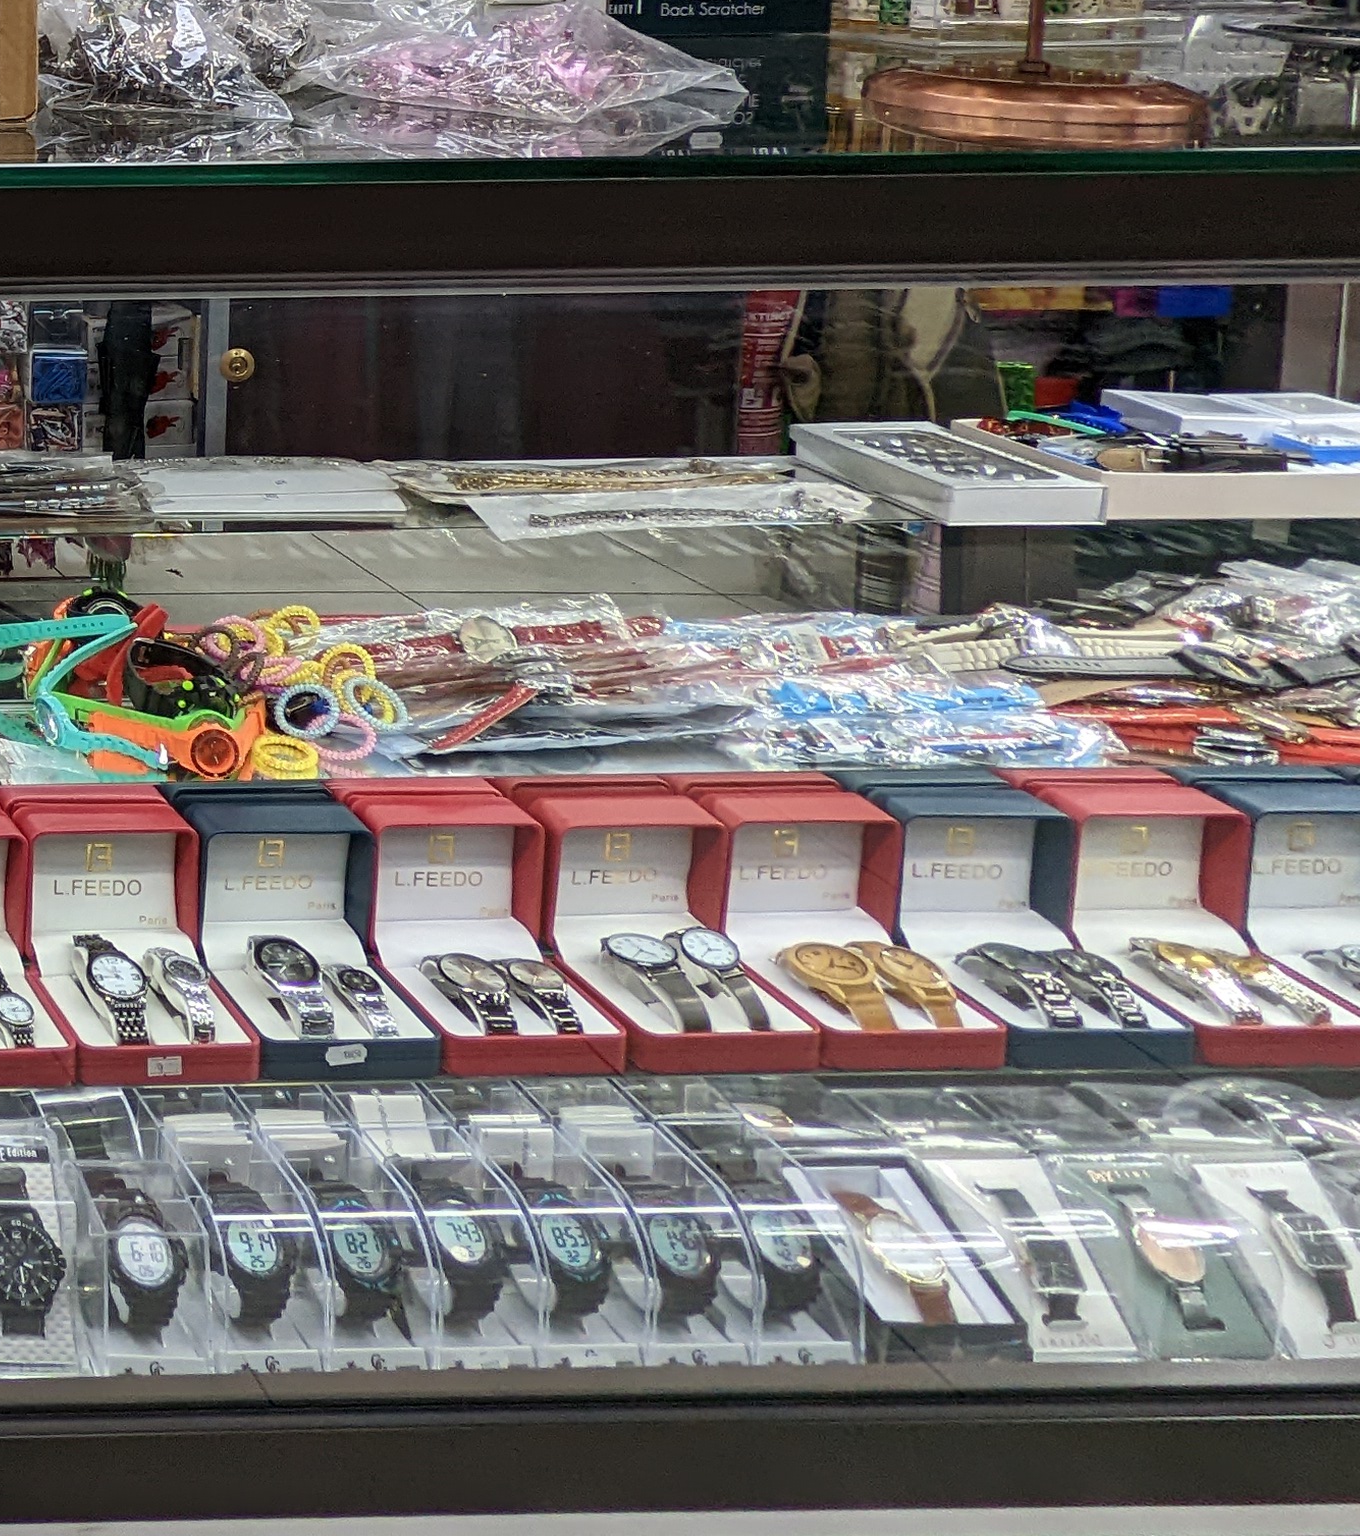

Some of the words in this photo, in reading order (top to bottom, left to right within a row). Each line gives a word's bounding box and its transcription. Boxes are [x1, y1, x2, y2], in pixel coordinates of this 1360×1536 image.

[660, 3, 696, 18] Back
[699, 2, 766, 17] Scratcher
[393, 869, 484, 889] L.FEEDO
[738, 862, 829, 882] L.FEEDO
[911, 862, 1005, 881] L.FEEDO
[53, 879, 142, 897] L.FEEDO
[224, 874, 314, 892] L.FEEDO
[307, 900, 338, 911] Paris
[138, 914, 169, 926] Paris
[6, 1147, 38, 1160] Edition
